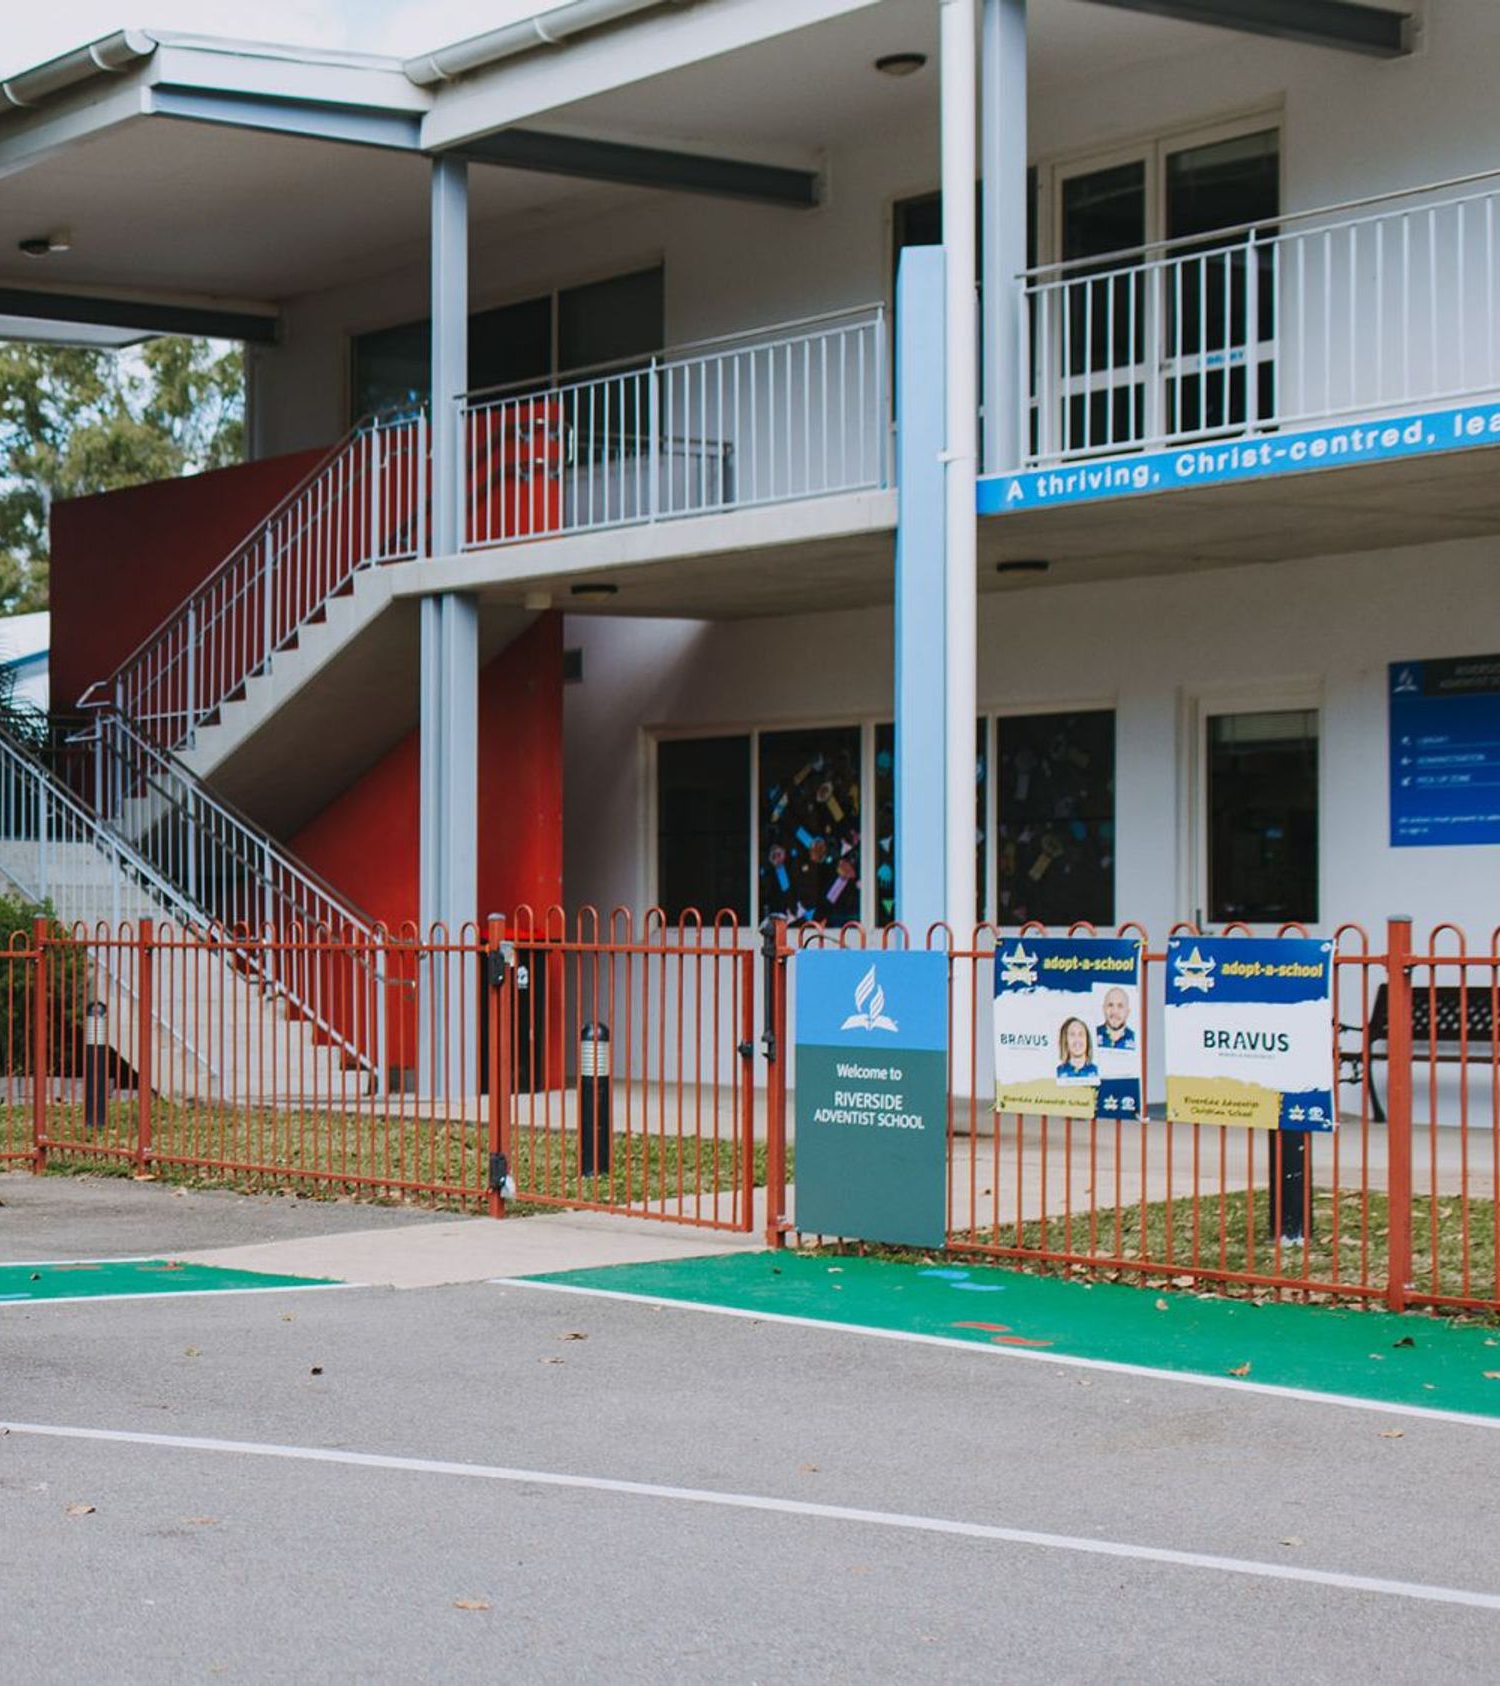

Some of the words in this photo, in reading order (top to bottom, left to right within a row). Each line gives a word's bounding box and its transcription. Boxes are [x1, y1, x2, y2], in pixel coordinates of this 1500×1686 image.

[1006, 479, 1025, 502] A
[1037, 464, 1161, 498] thriving,
[1174, 419, 1436, 478] Christ-centred,
[1043, 954, 1134, 973] adopt-a-school
[1220, 960, 1324, 979] adopt-a-school
[1000, 1033, 1049, 1047] BRAVUS
[1203, 1029, 1290, 1053] BRAVUS
[836, 1063, 888, 1080] Welcome
[889, 1067, 903, 1081] to
[833, 1090, 904, 1111] RIVERSIDE
[813, 1108, 876, 1125] ADVENTIST
[876, 1112, 926, 1130] SCHOOL
